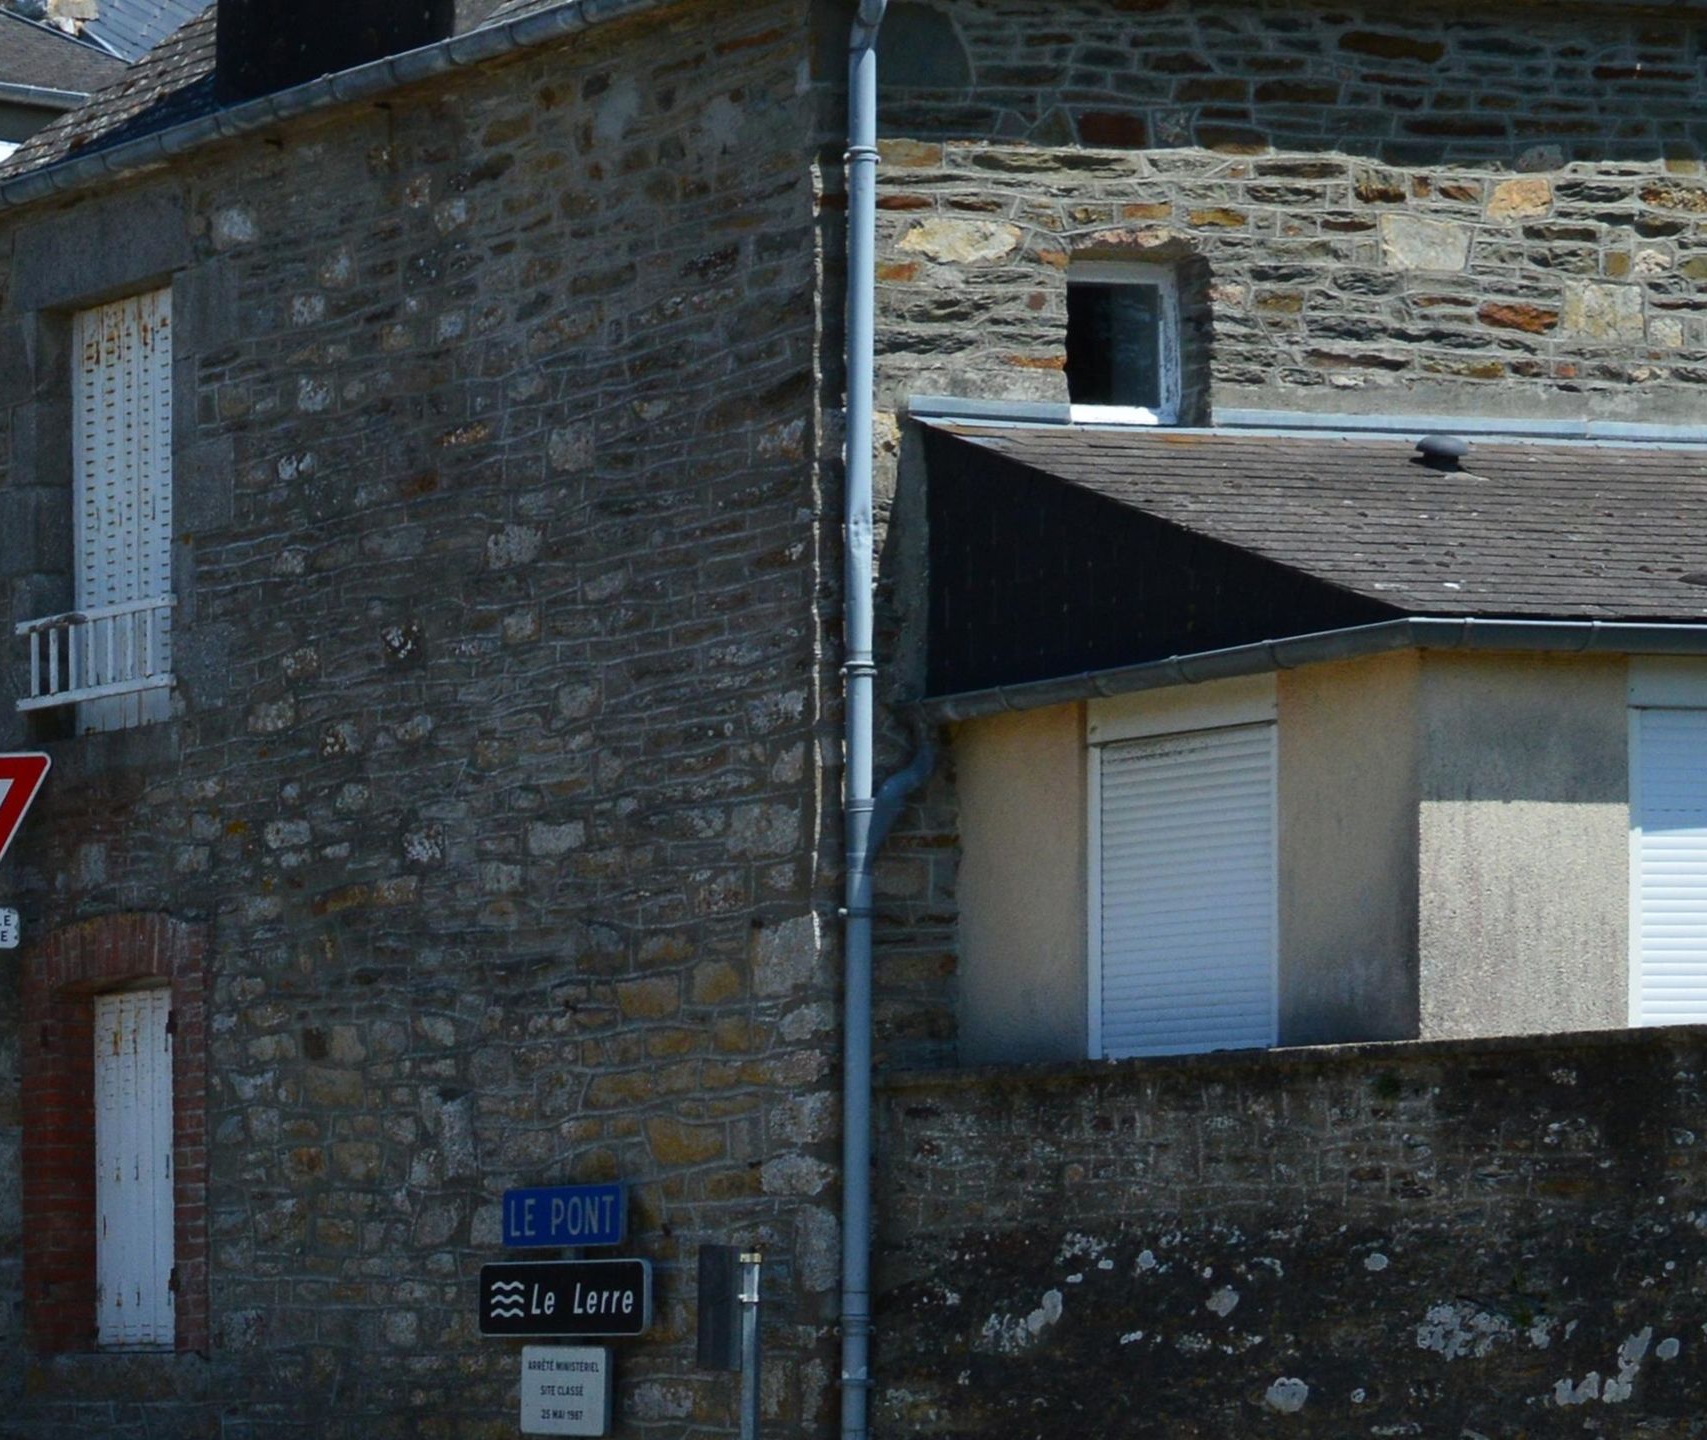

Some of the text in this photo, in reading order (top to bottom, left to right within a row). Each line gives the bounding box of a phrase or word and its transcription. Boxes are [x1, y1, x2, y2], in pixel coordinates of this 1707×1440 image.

[510, 1195, 615, 1237] LE PONT
[531, 1282, 634, 1315] Le Lerre
[540, 1385, 555, 1396] SITE
